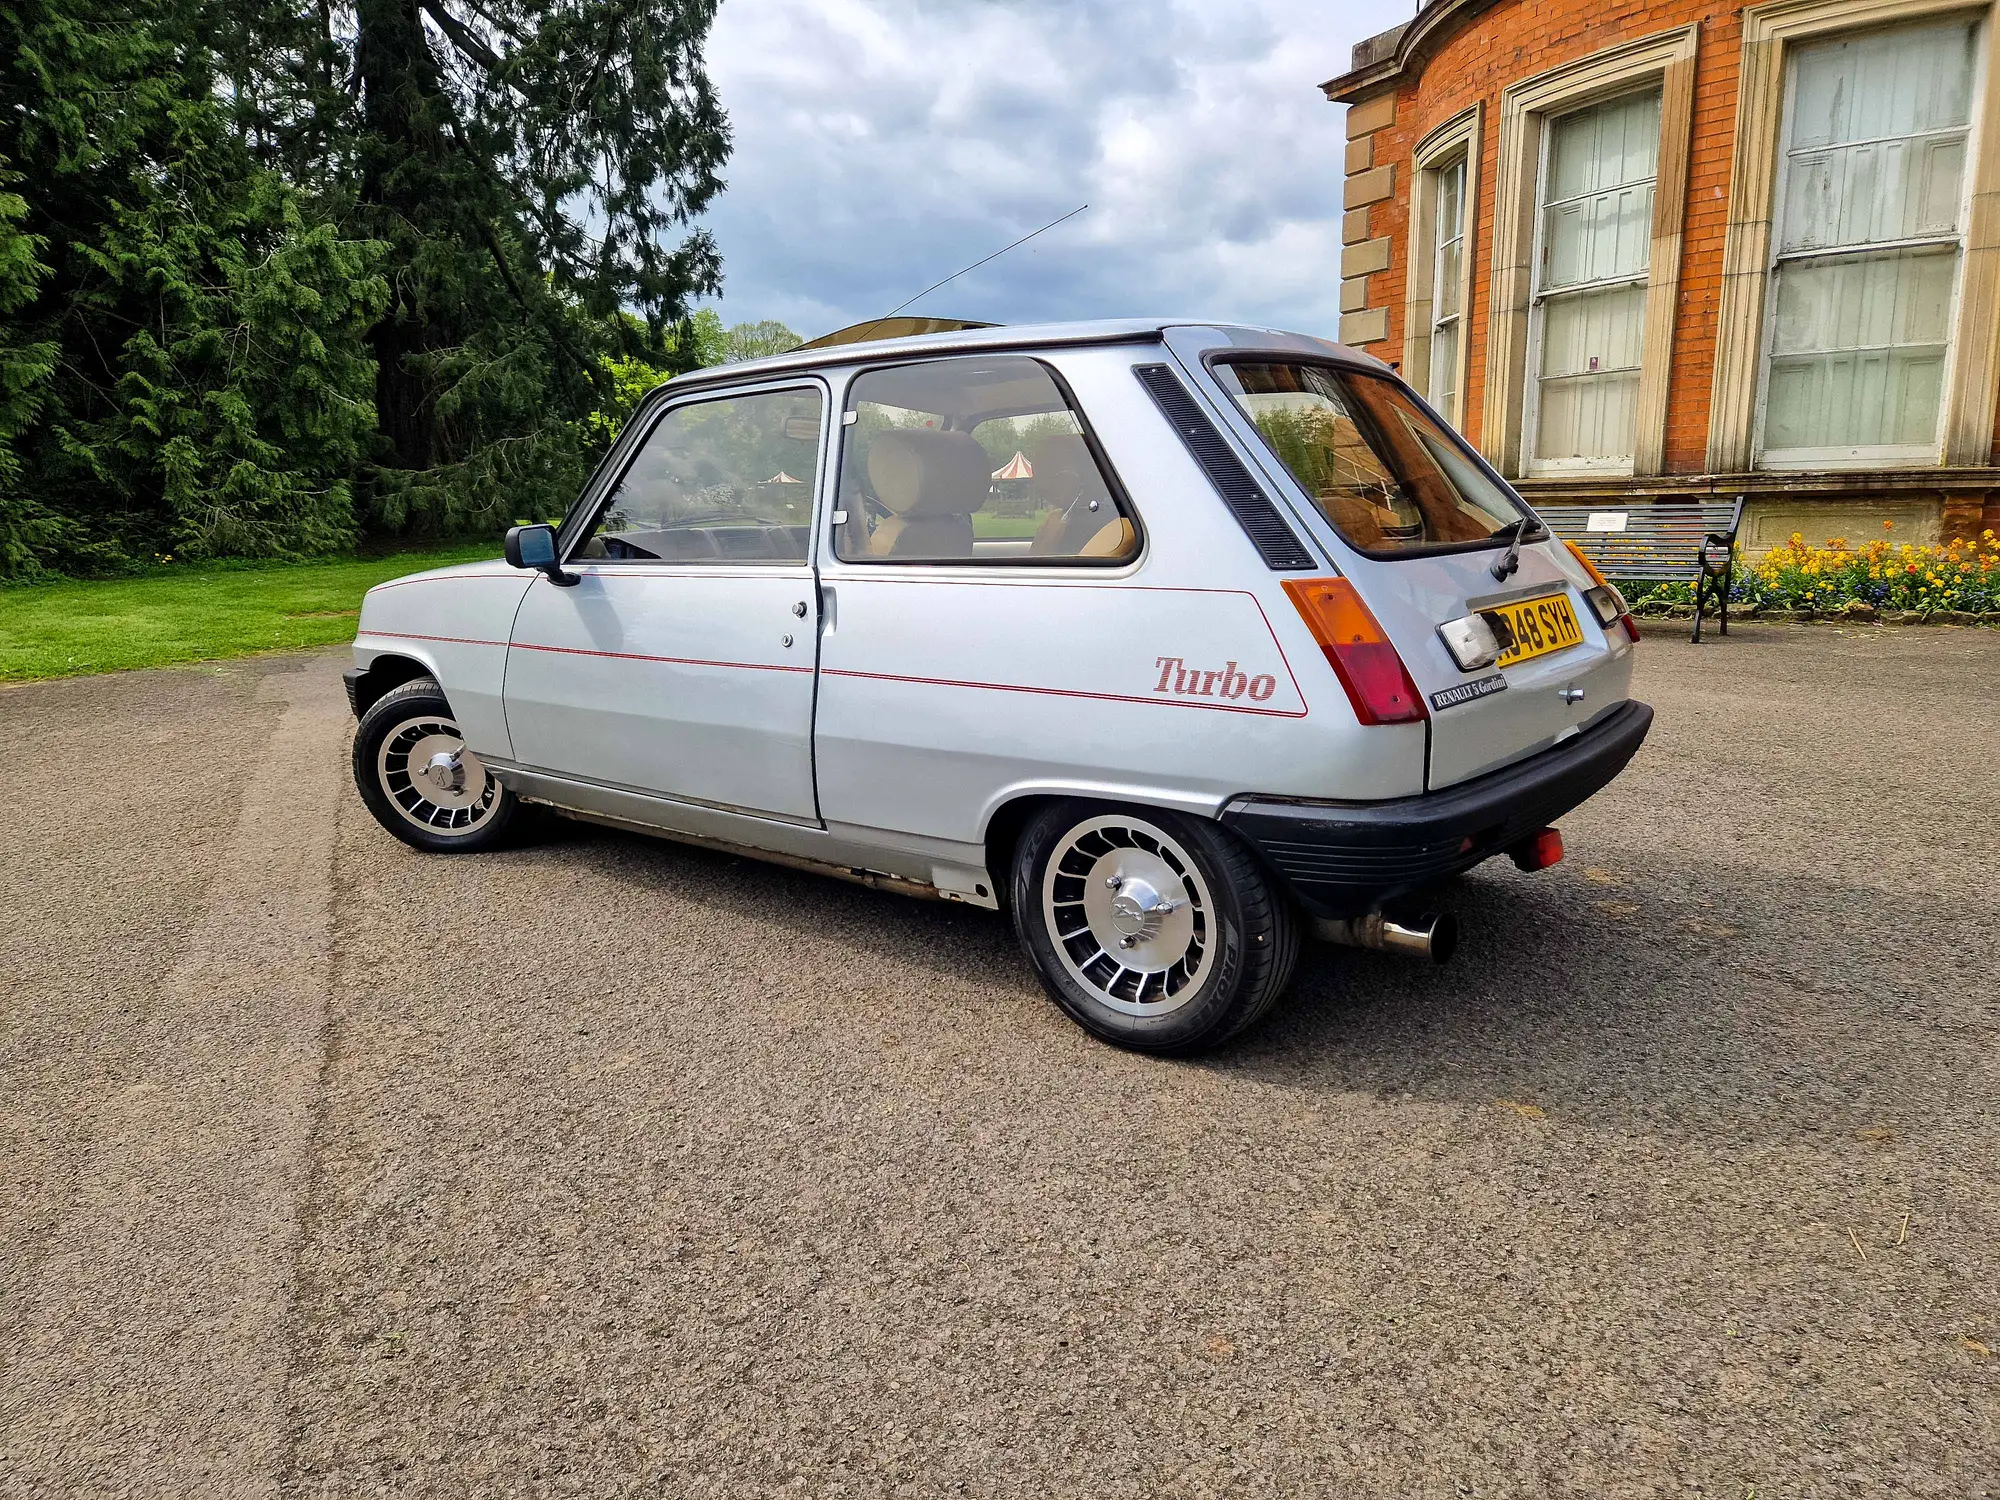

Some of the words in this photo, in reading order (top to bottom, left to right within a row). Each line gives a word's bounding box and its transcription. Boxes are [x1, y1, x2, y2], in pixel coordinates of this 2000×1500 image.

[1537, 600, 1577, 644] SYH
[1153, 656, 1276, 702] Turbo
[1434, 684, 1474, 707] RENAULT
[1472, 683, 1480, 695] 5
[1478, 675, 1506, 694] Gordini
